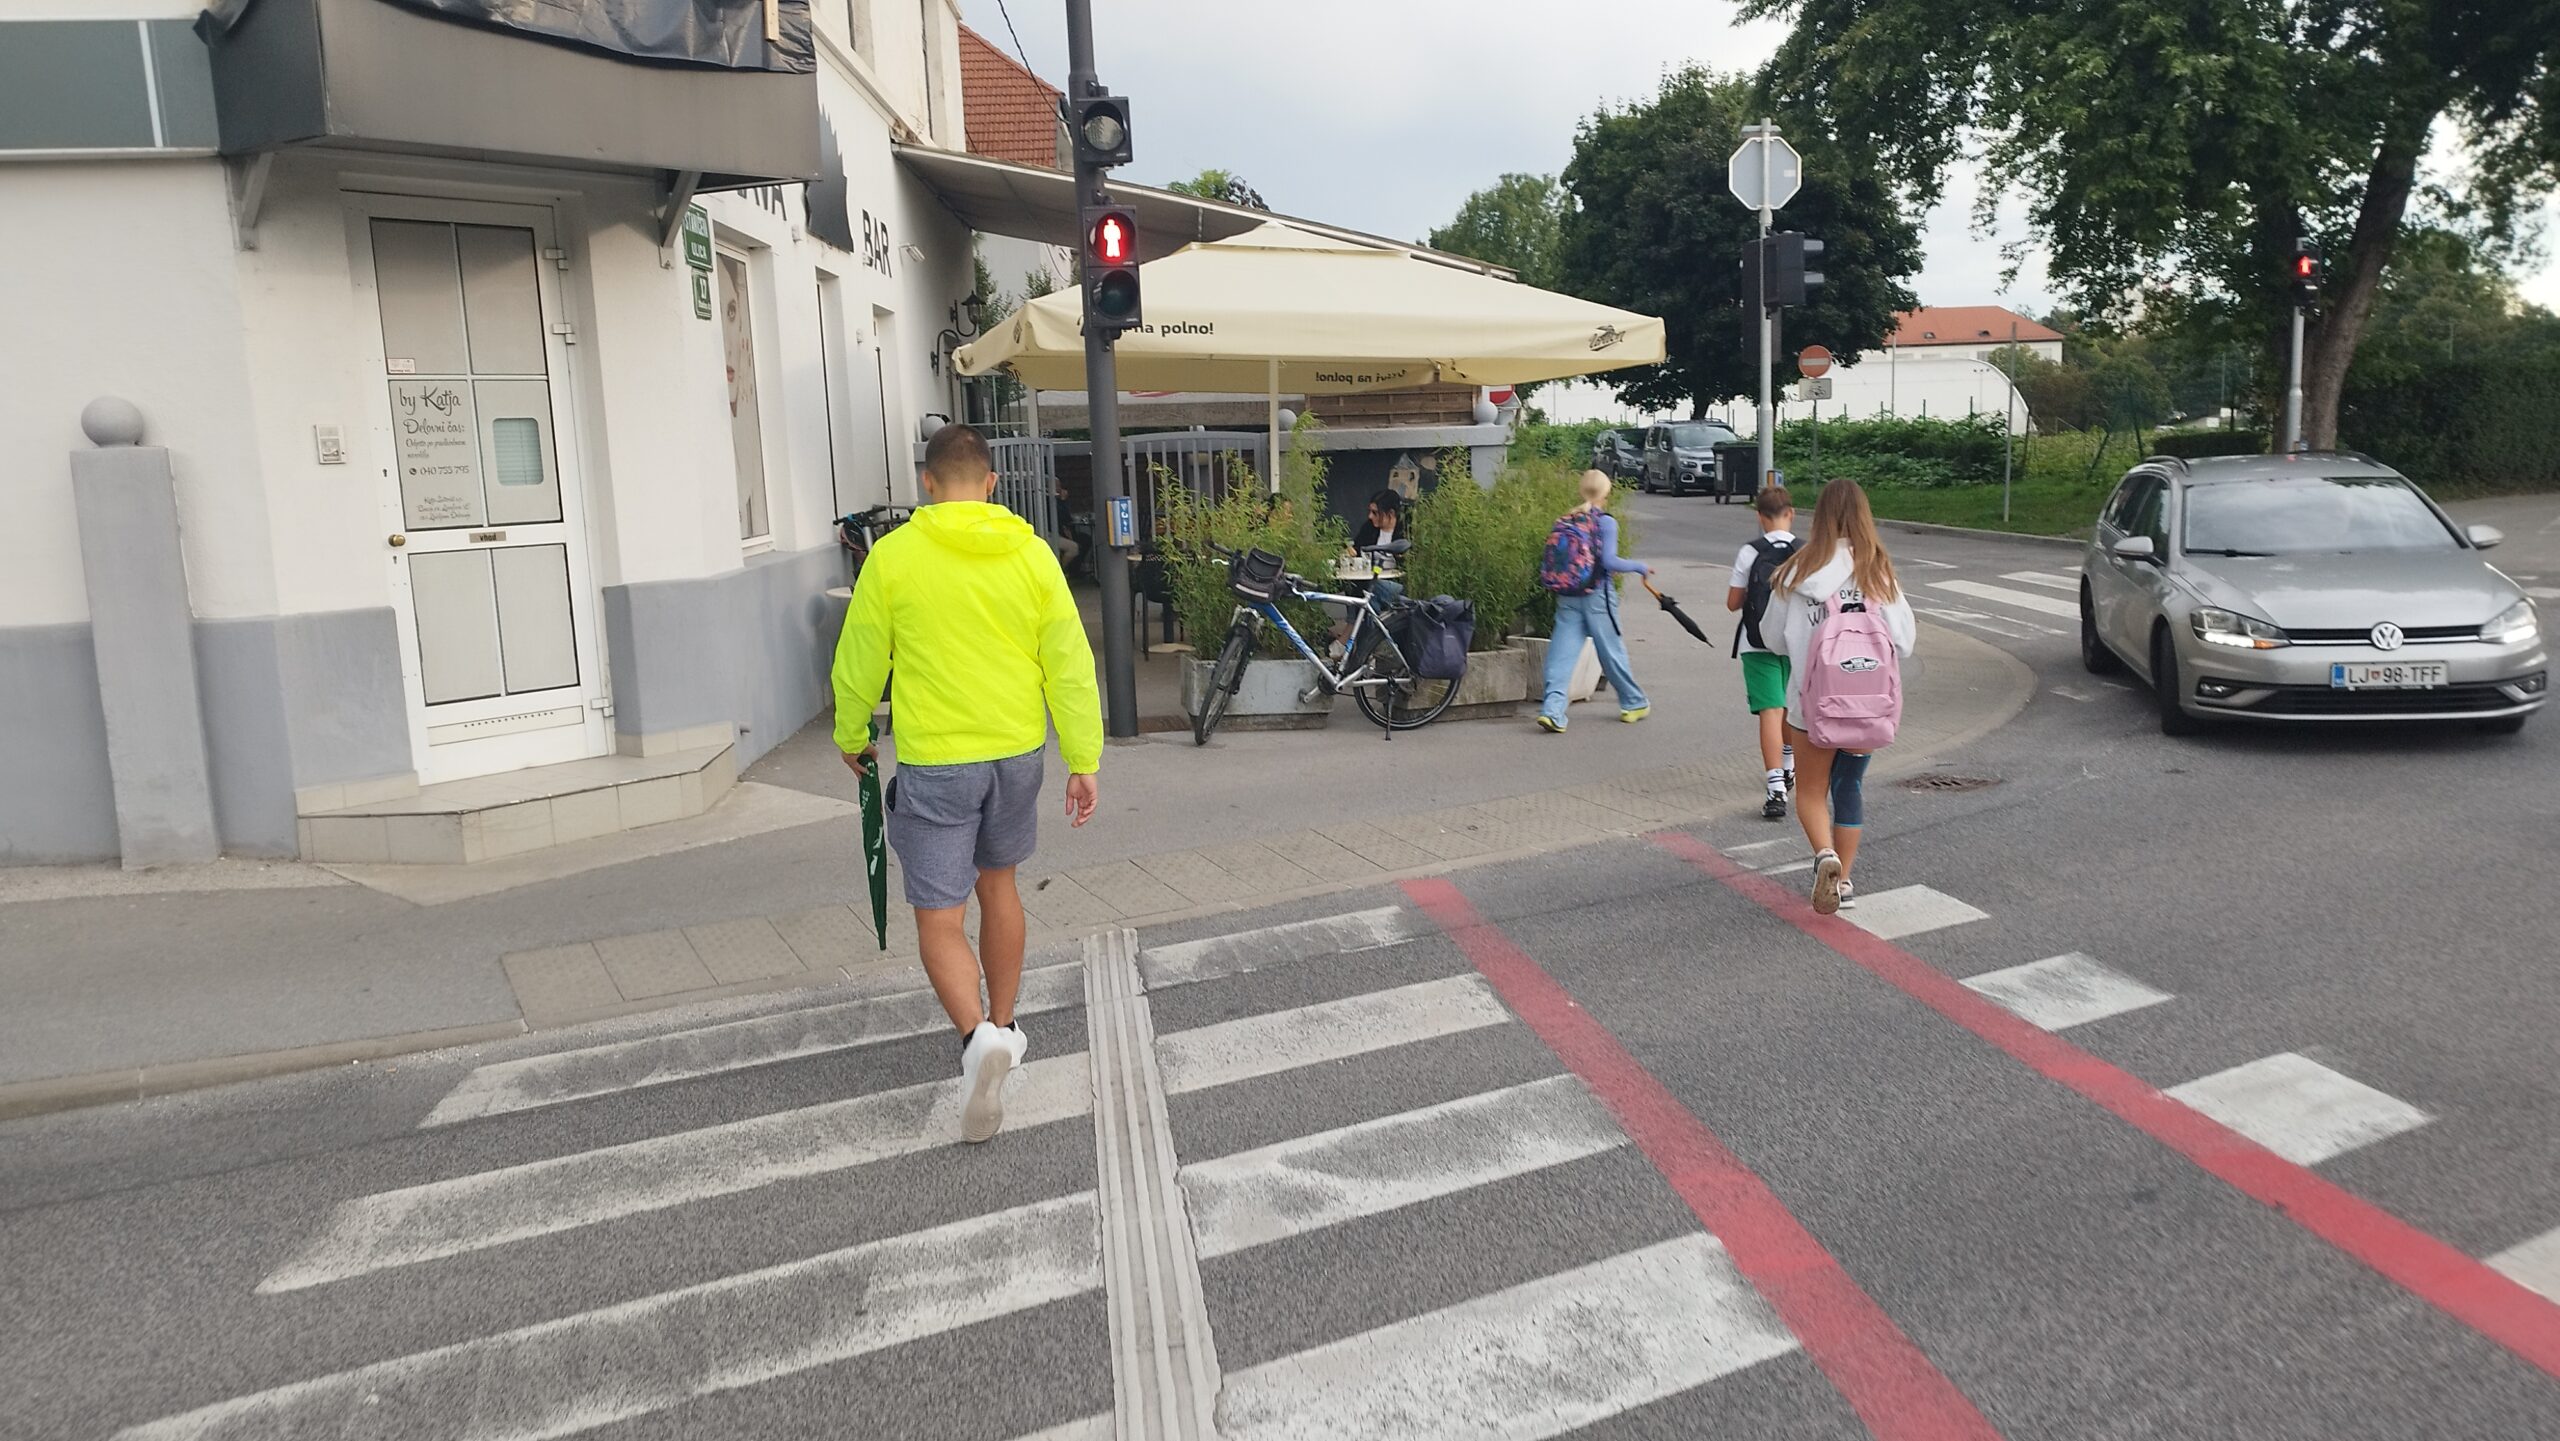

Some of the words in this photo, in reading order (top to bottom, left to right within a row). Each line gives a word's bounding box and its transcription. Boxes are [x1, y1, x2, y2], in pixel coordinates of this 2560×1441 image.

[862, 208, 892, 278] BAR
[1161, 321, 1214, 337] polno!
[399, 385, 416, 416] by
[420, 385, 461, 416] Katja
[403, 417, 445, 435] Delovni
[2348, 667, 2369, 684] LJ
